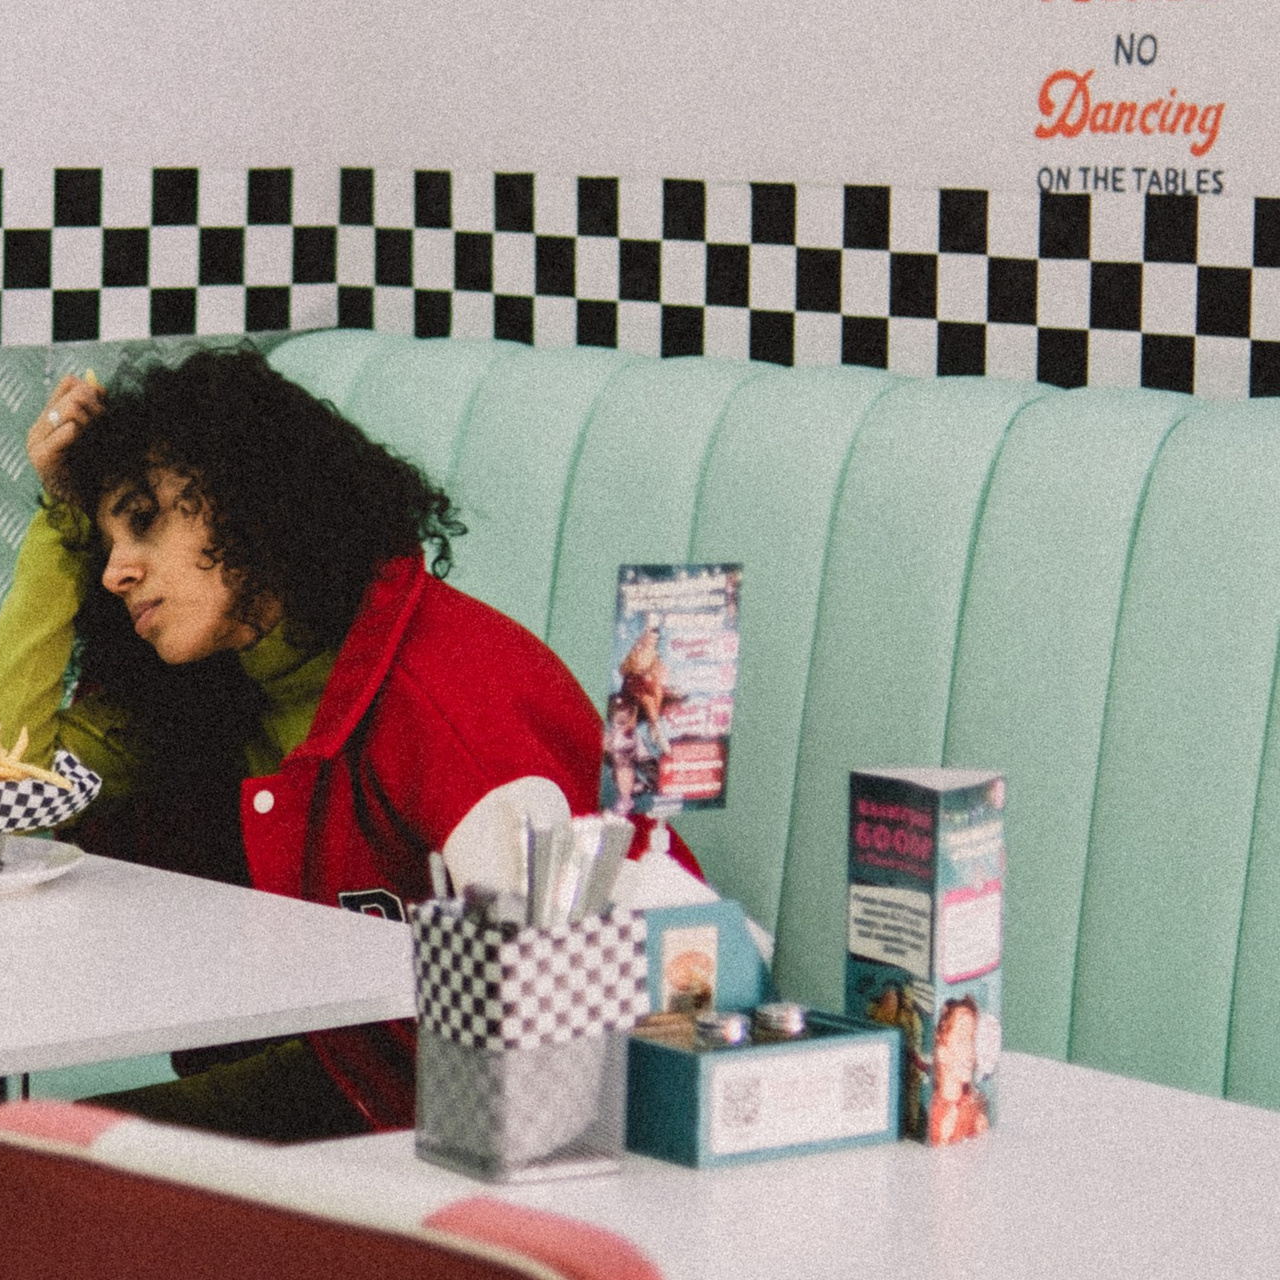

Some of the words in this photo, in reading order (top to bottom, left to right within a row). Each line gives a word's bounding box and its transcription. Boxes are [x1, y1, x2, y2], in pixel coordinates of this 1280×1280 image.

[1114, 33, 1158, 66] NO
[1034, 67, 1226, 157] Dancing
[1037, 166, 1071, 194] ON
[1078, 166, 1125, 193] THE
[1132, 167, 1225, 195] TABLES
